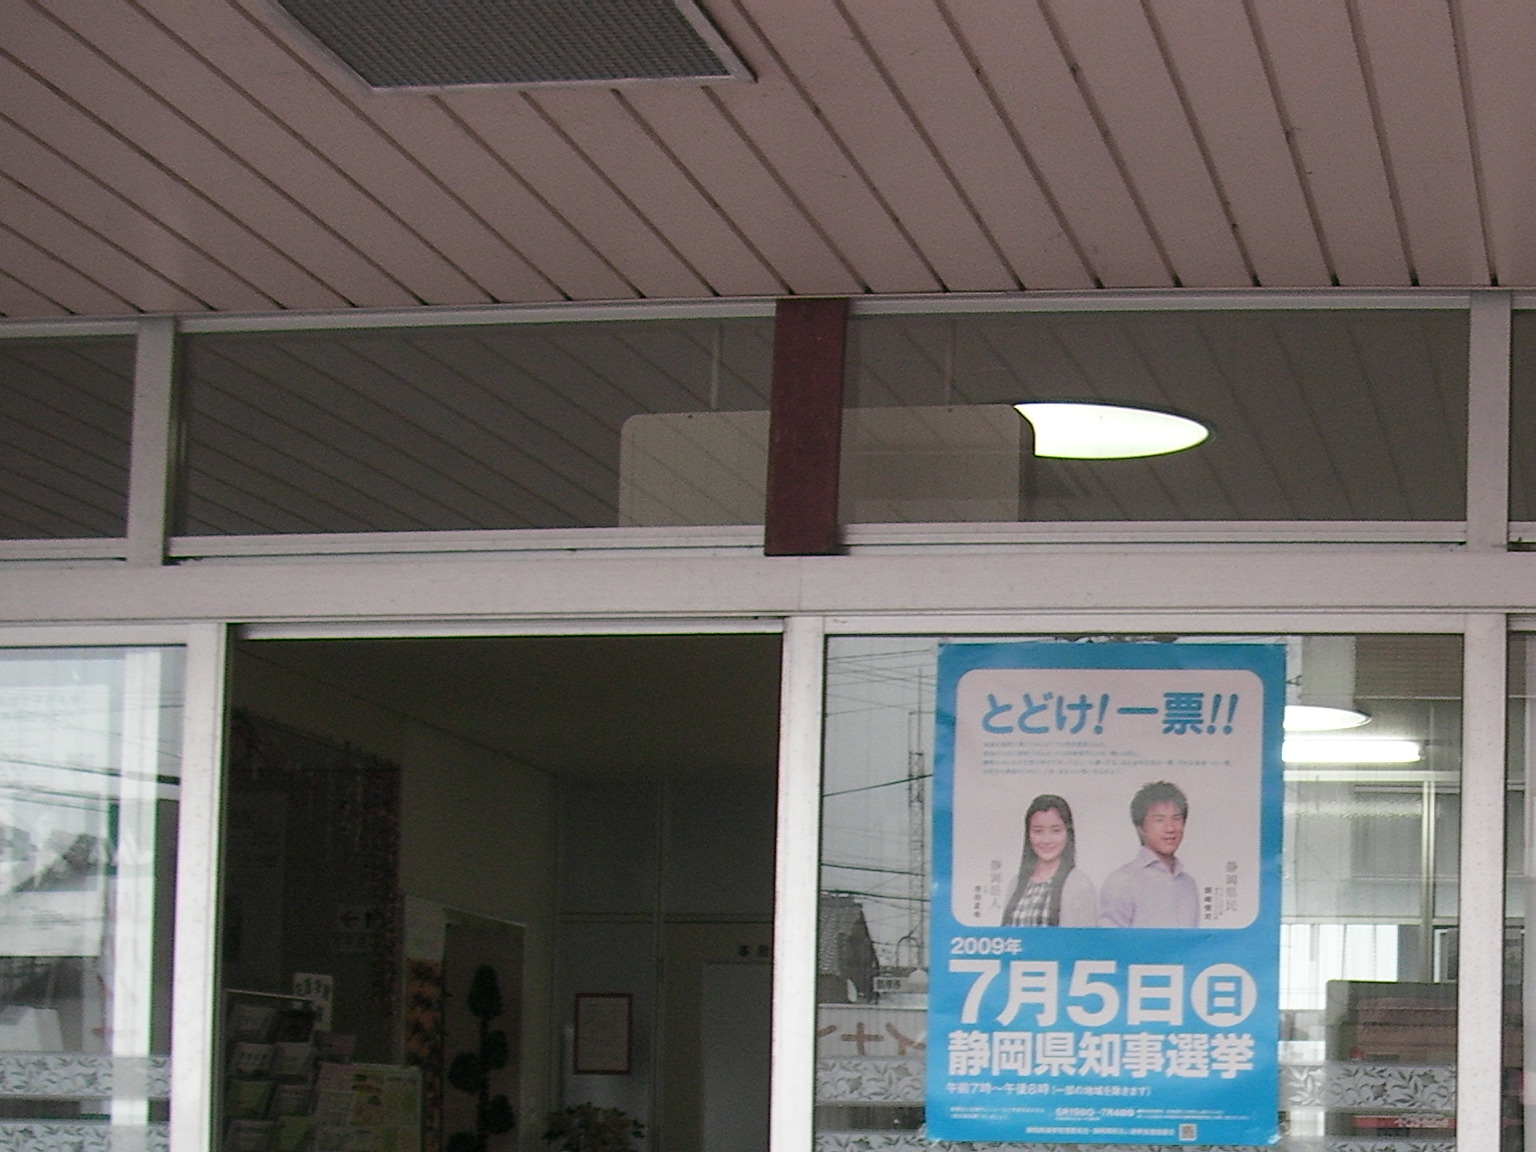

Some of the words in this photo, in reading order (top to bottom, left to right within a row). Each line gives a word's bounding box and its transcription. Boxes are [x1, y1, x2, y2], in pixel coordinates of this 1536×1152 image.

[950, 937, 1023, 955] 2009年
[948, 1032, 1254, 1080] 静岡県知事選挙
